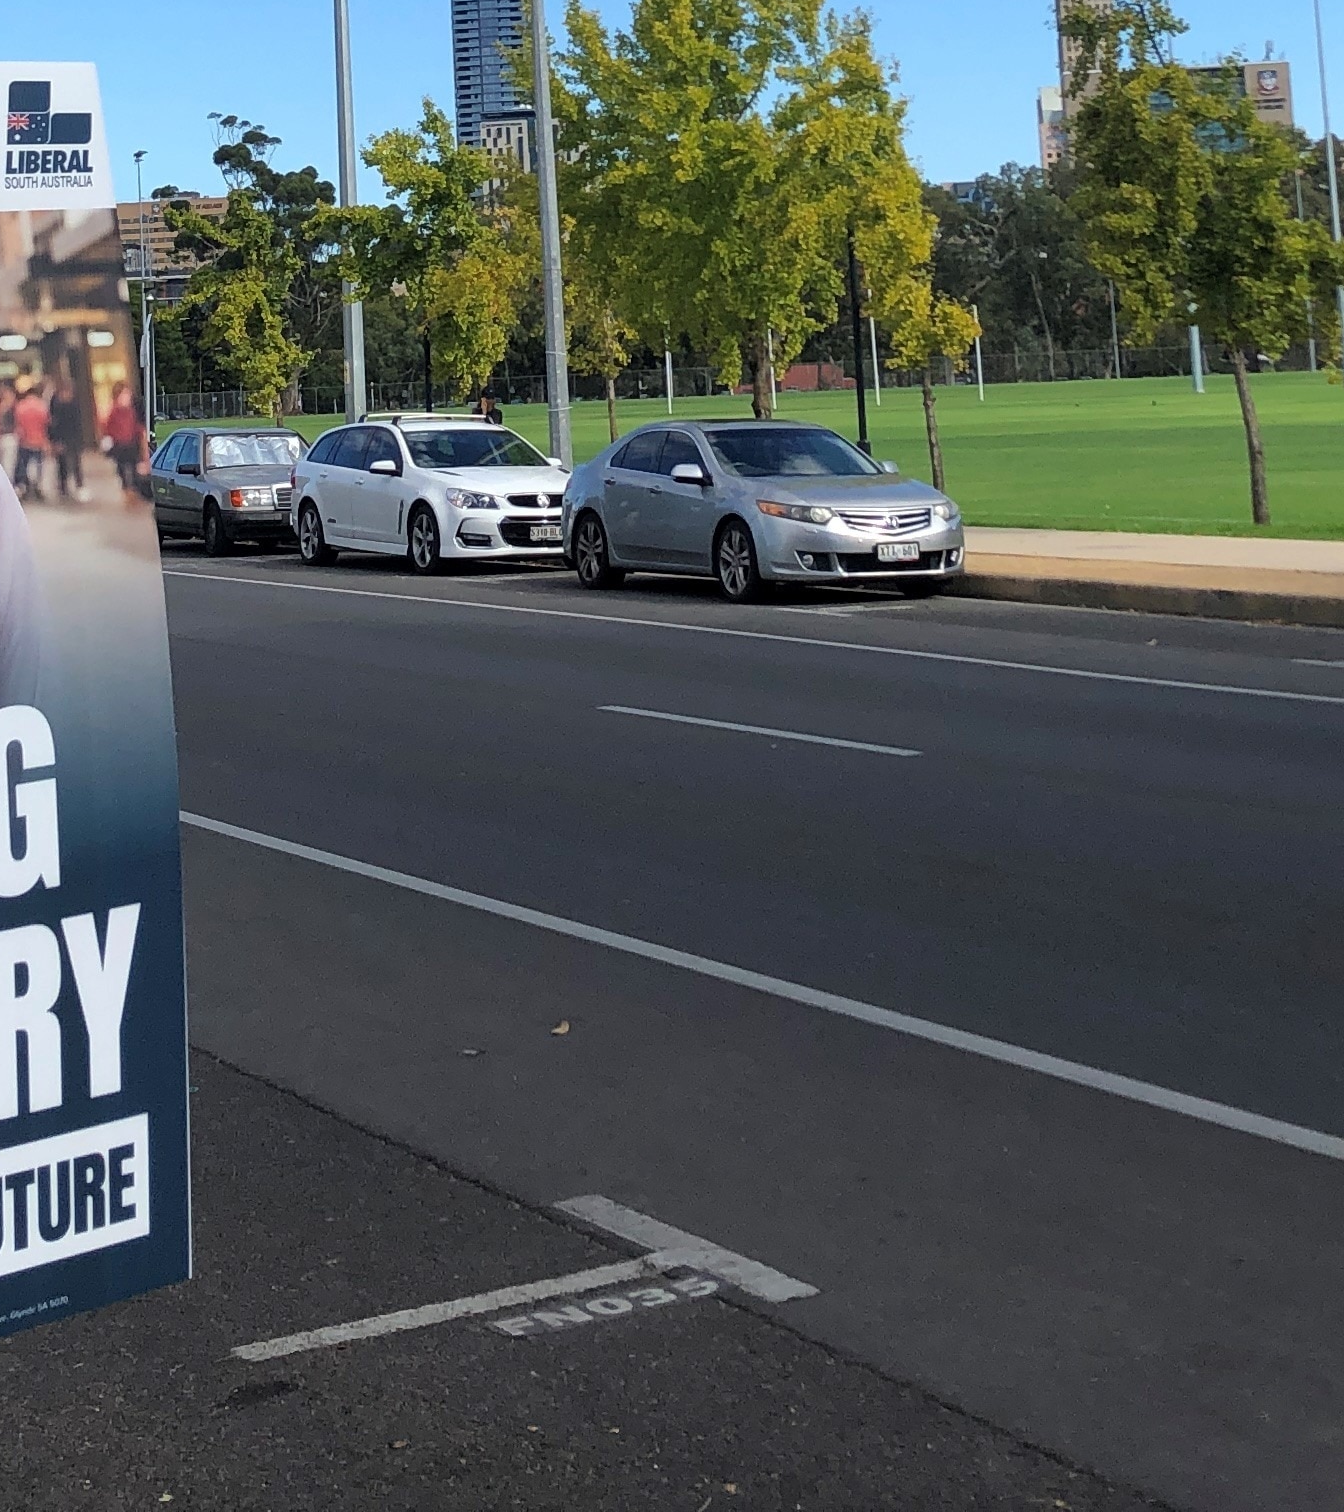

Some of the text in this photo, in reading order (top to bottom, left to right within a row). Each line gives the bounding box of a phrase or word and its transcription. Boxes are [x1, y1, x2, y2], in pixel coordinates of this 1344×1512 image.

[6, 149, 94, 175] LIBERAL
[4, 175, 93, 189] SOUTH AUSTRALIA
